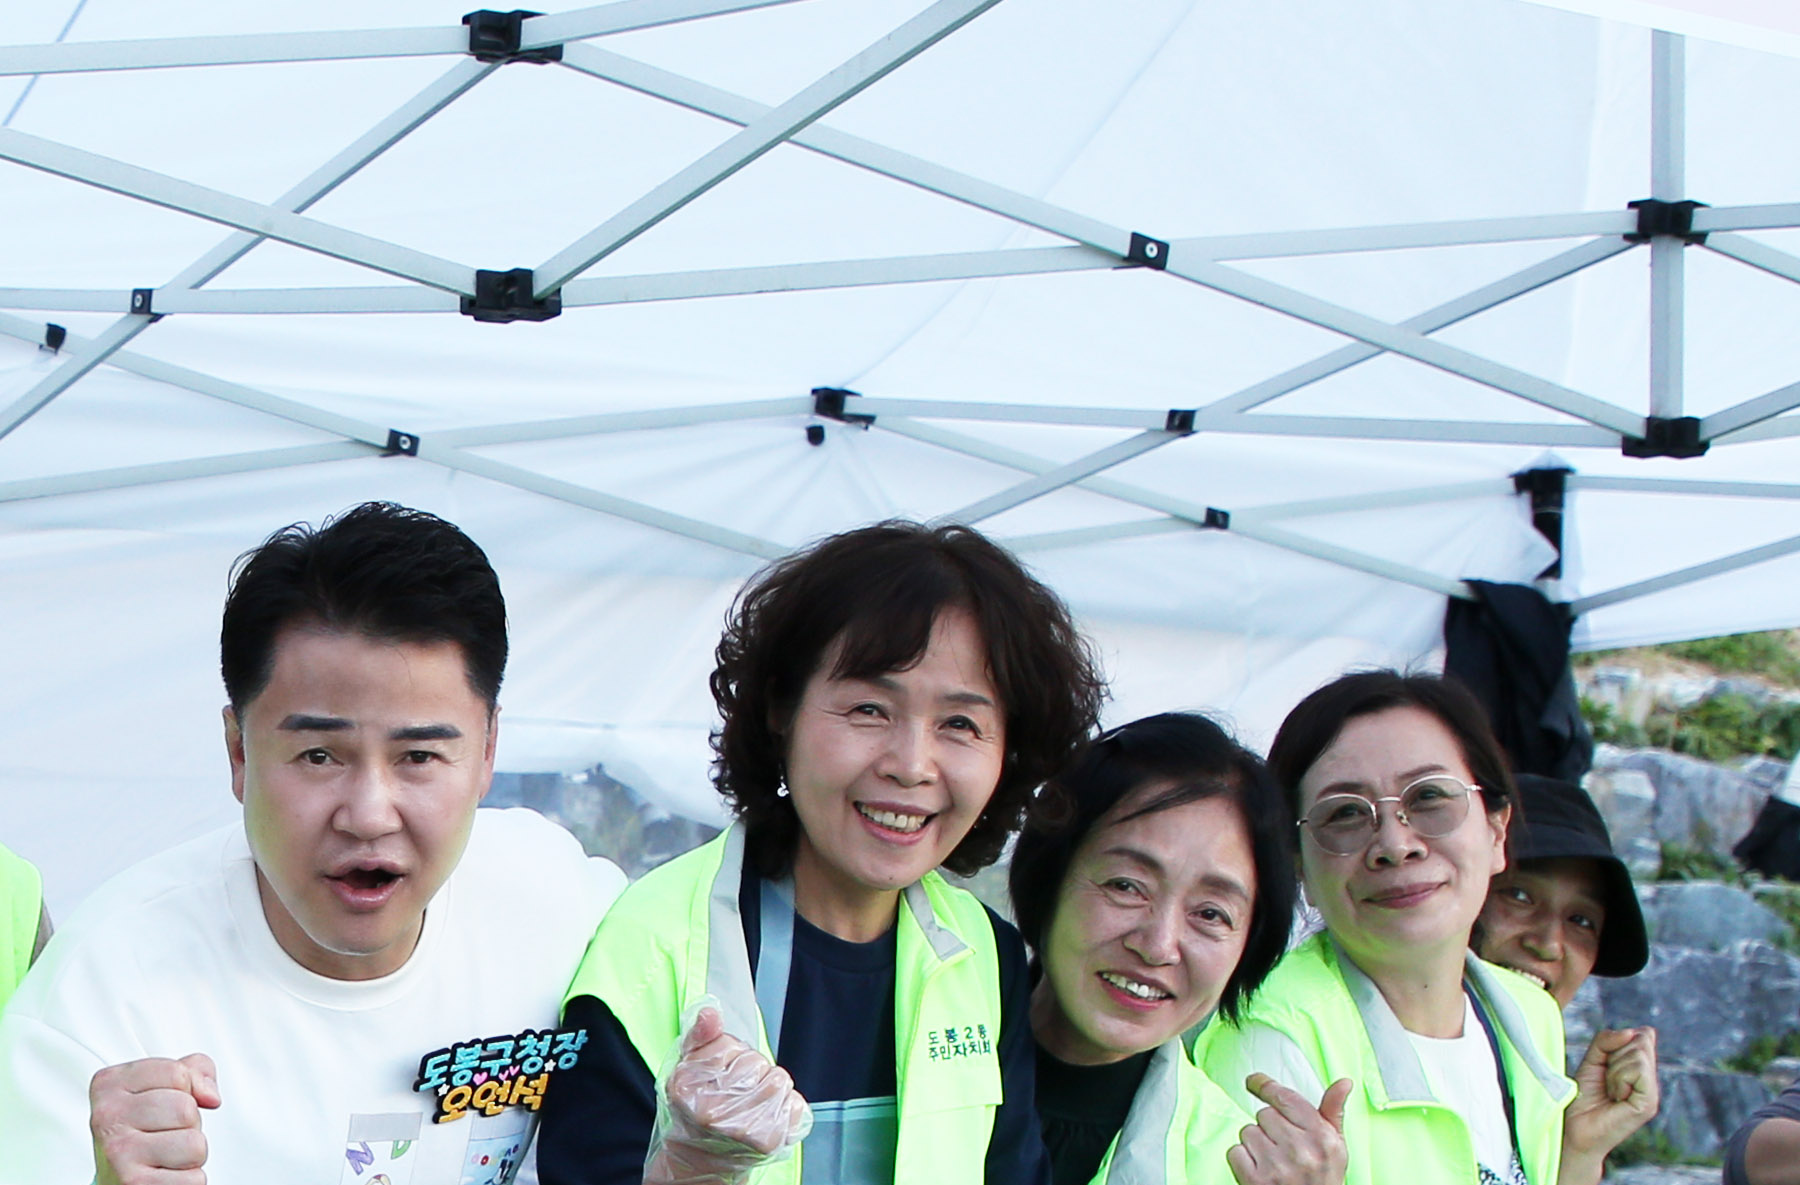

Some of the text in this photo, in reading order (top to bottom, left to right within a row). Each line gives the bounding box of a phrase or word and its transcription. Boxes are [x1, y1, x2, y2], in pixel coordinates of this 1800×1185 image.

[417, 1028, 590, 1092] 도봉구청장
[927, 1039, 992, 1062] 주민자치회
[437, 1072, 550, 1124] 오언석
